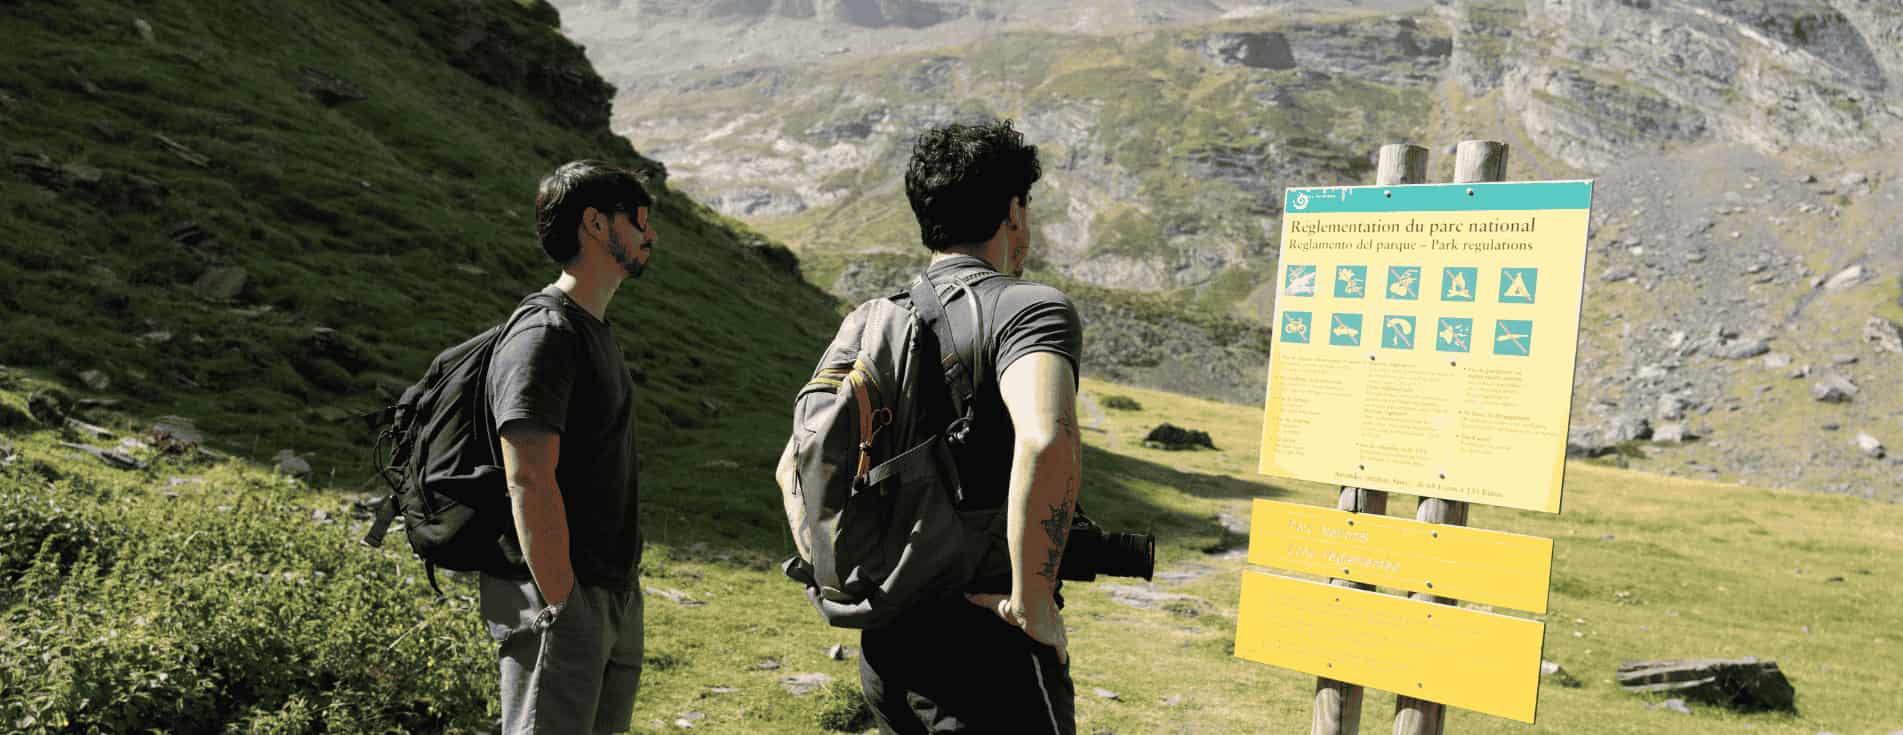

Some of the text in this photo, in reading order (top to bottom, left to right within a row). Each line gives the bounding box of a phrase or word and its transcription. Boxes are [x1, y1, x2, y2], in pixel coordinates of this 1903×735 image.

[1405, 217, 1424, 233] du
[1429, 221, 1464, 237] parc
[1468, 216, 1535, 233] national
[1289, 239, 1353, 251] Reglamento
[1356, 239, 1373, 250] del
[1376, 240, 1417, 253] parque
[1431, 238, 1459, 251] Park
[1463, 239, 1533, 252] regulations
